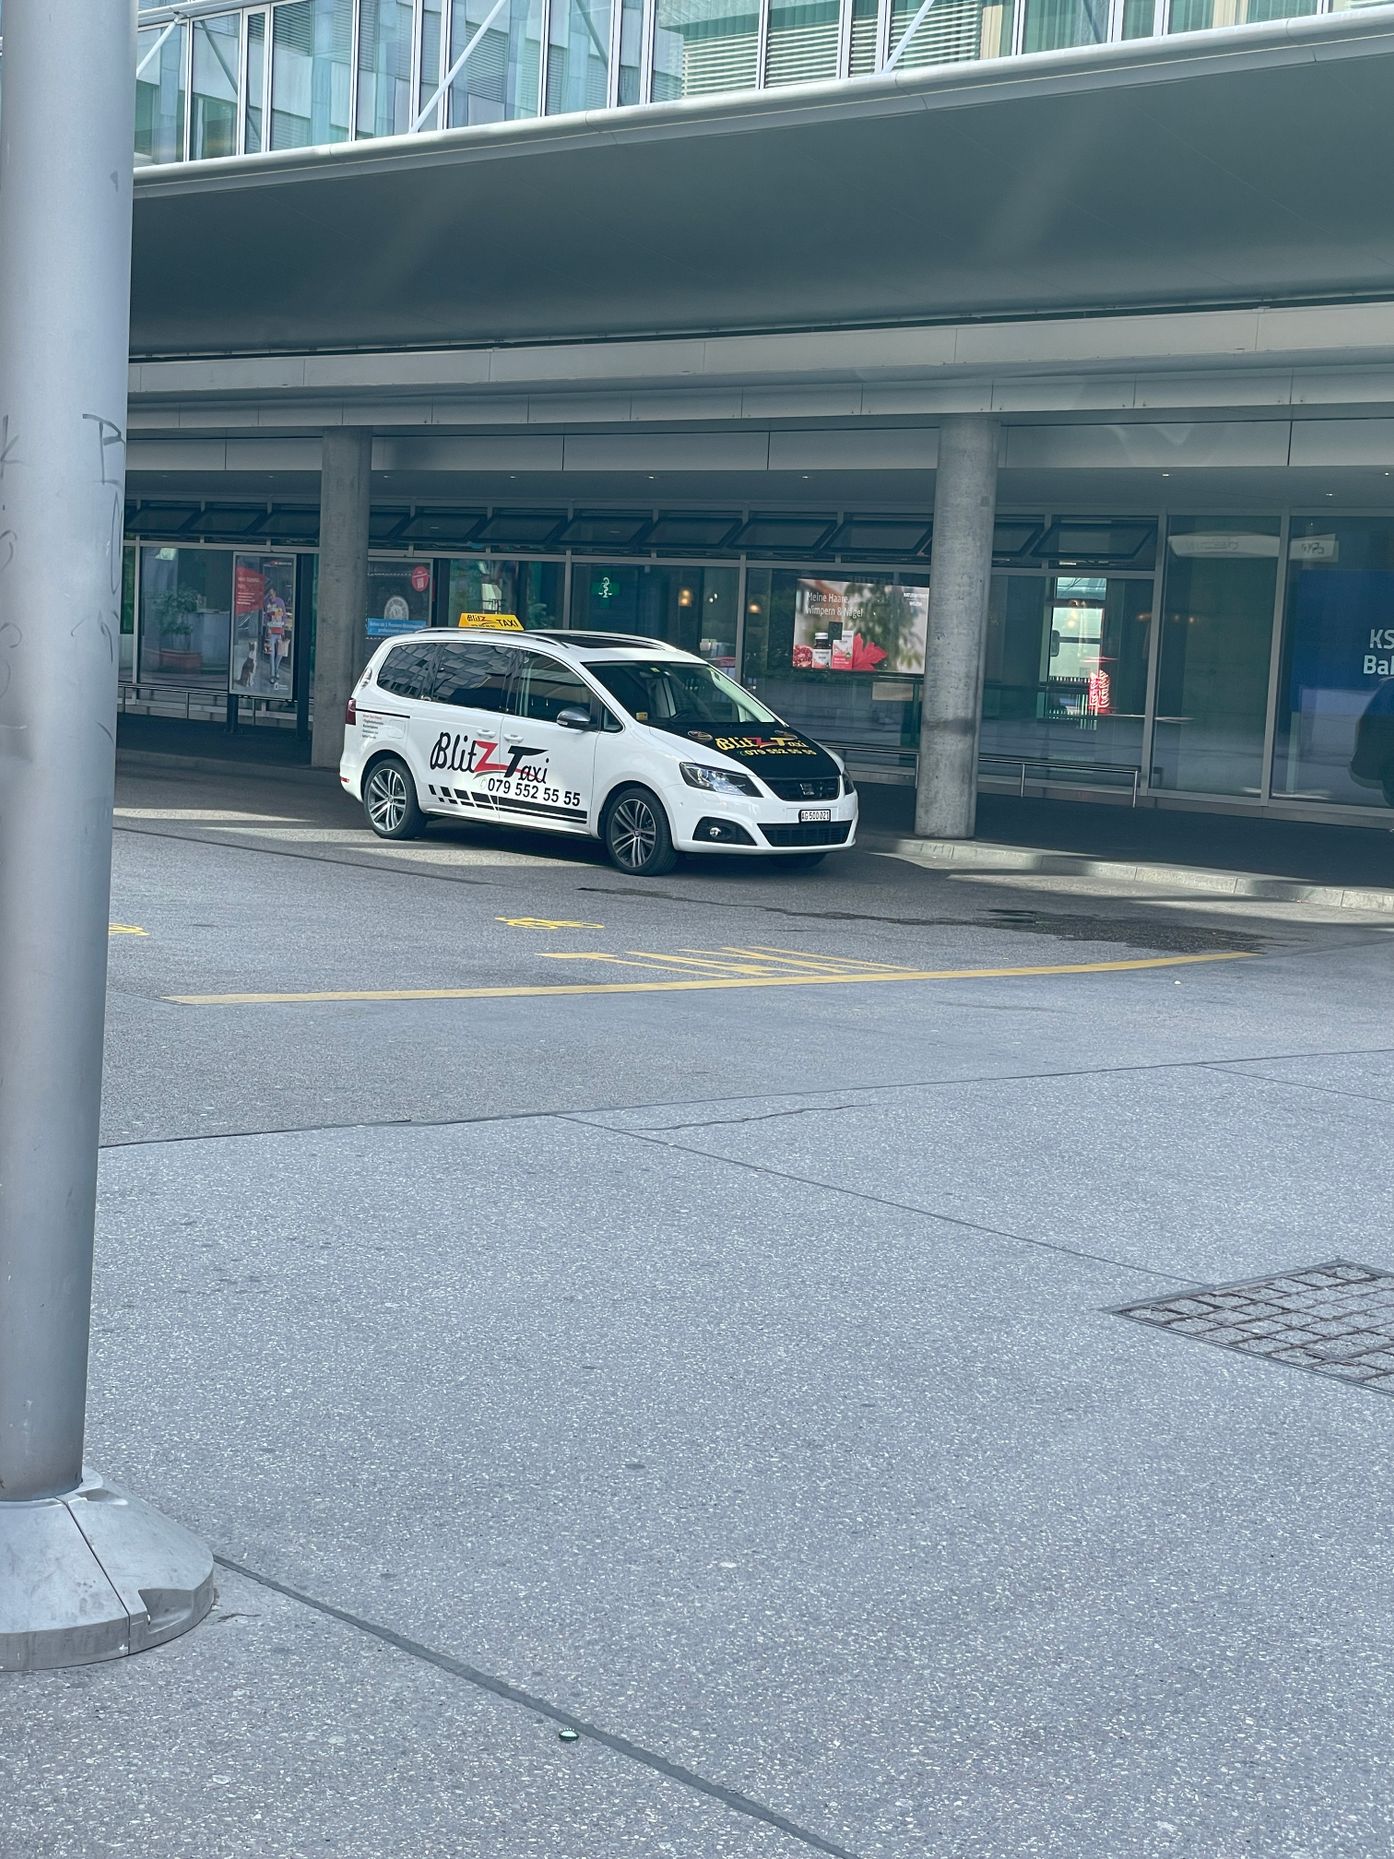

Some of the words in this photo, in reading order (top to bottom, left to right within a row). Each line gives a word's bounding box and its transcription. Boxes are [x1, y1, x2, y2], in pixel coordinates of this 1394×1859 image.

[496, 619, 519, 627] TAXI
[504, 745, 549, 784] Taxi
[488, 778, 511, 794] 079
[515, 782, 539, 799] 552
[543, 787, 560, 803] 55
[564, 791, 581, 807] 55
